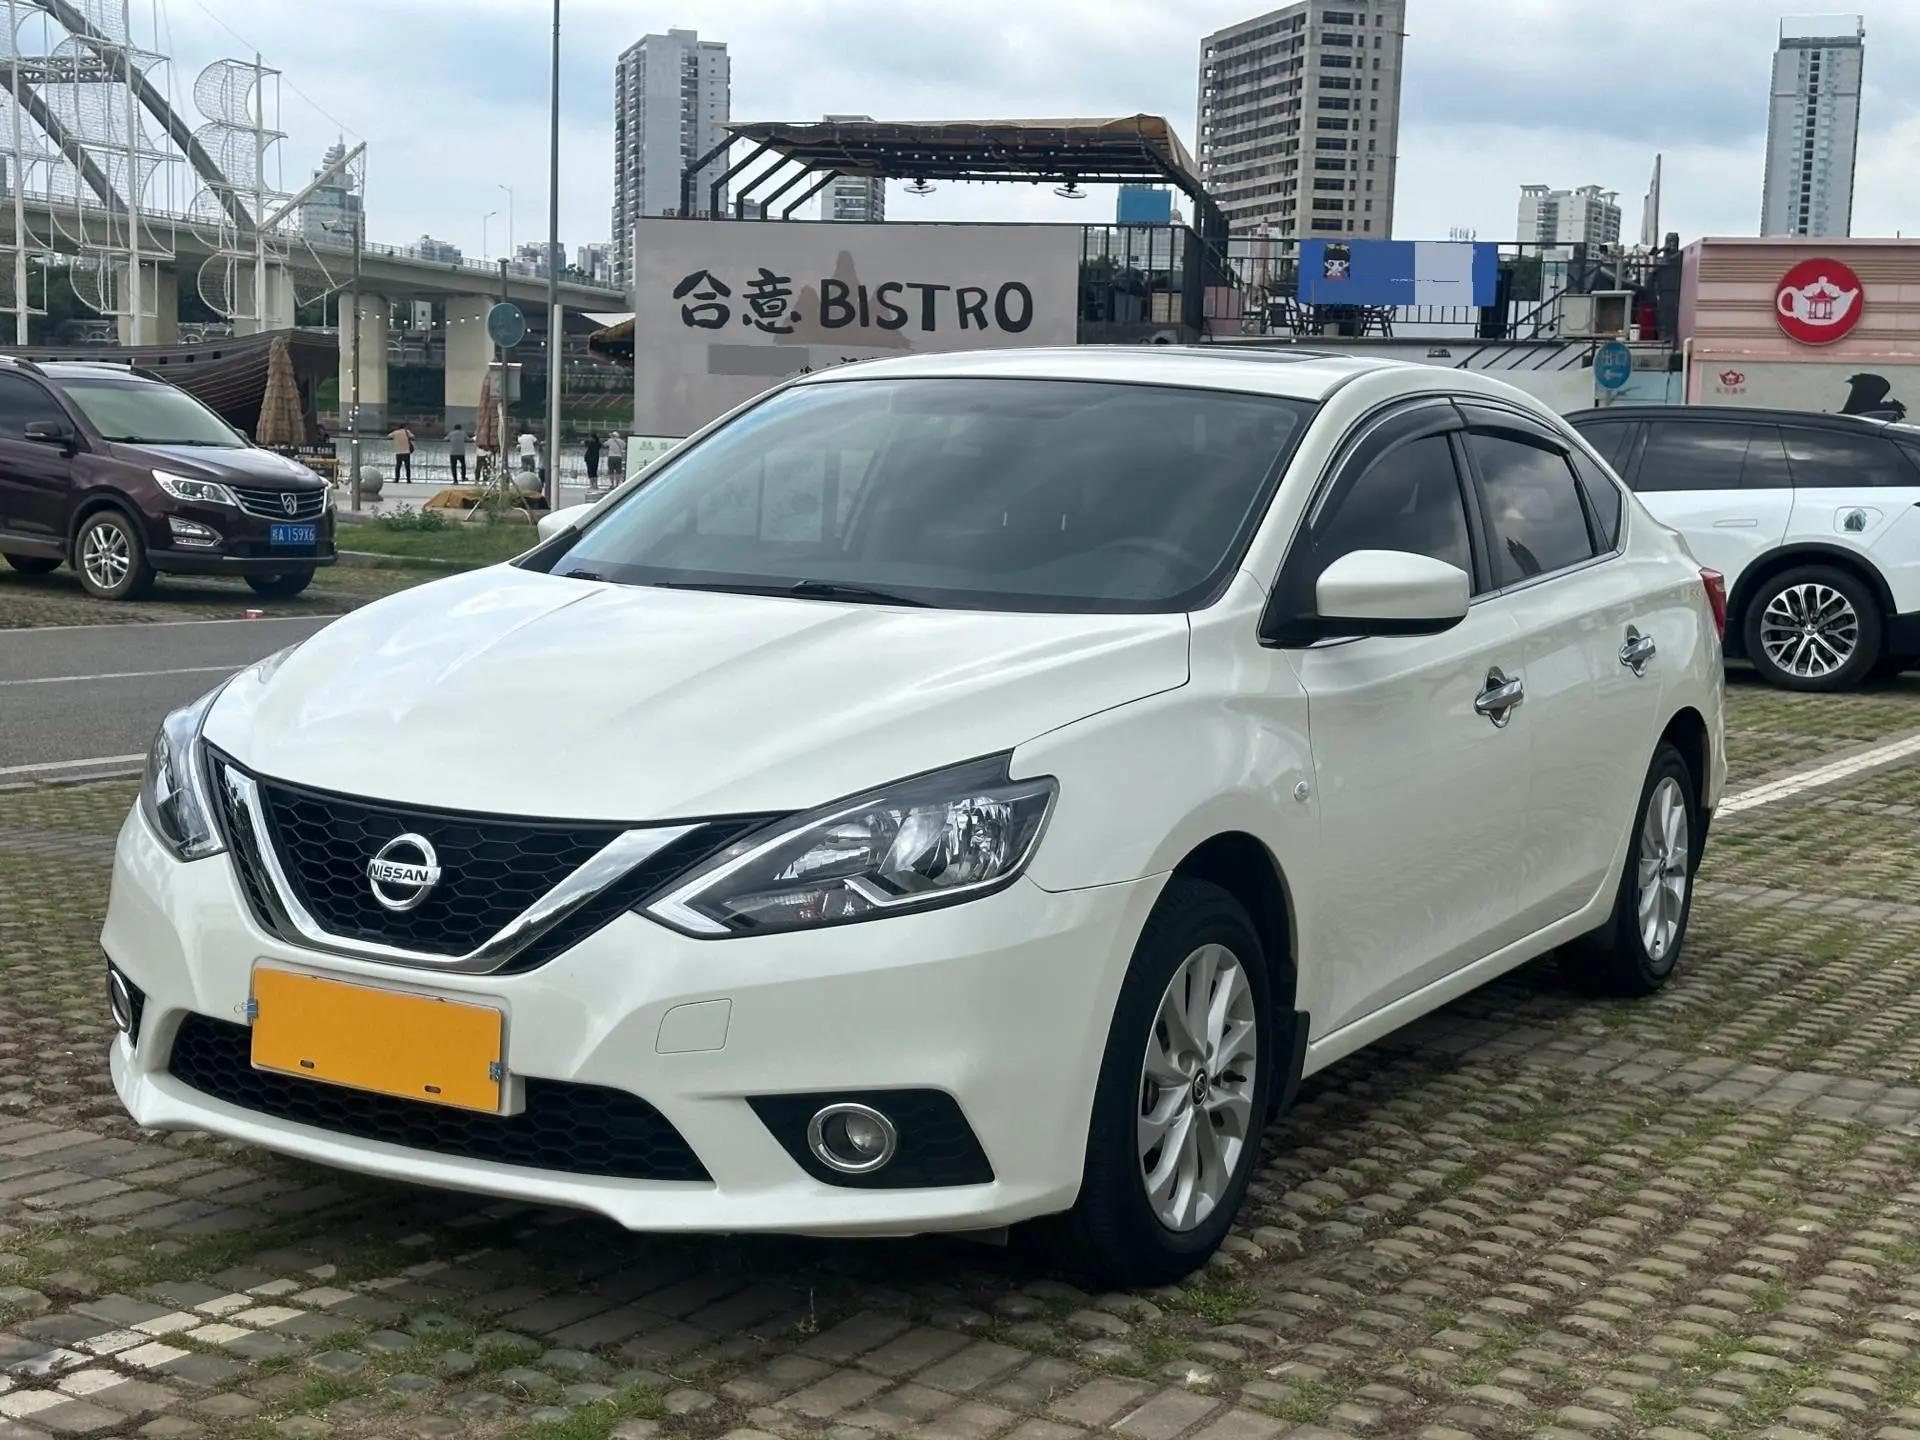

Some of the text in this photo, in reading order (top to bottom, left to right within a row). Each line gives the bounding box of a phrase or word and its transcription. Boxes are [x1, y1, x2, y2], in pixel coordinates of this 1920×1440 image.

[673, 268, 1033, 334] 合意 BISTRO
[368, 863, 429, 882] NISSAN
